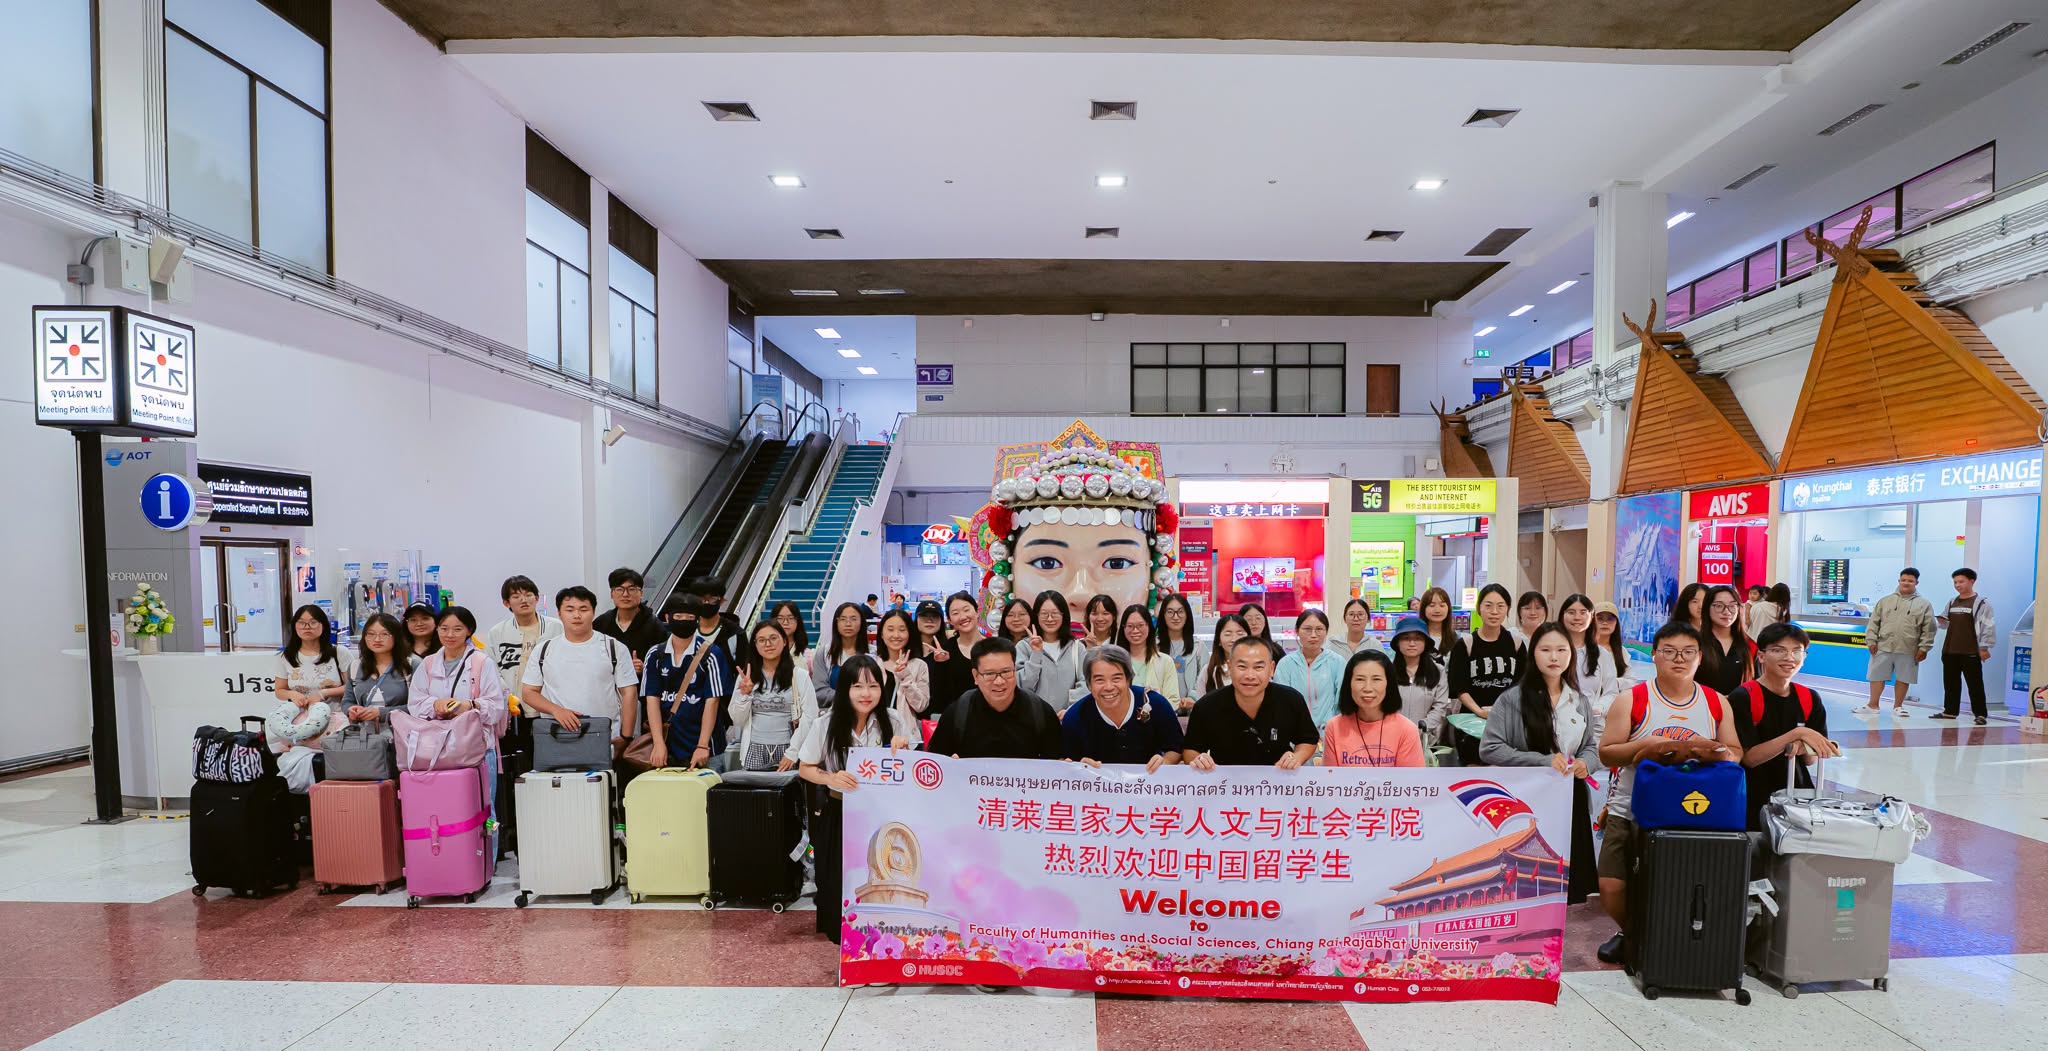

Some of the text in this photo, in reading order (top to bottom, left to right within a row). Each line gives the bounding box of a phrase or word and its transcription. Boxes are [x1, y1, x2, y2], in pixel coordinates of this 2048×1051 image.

[50, 386, 102, 403] จุดนัดพบ
[141, 393, 185, 410] จุดนัดพบ
[39, 405, 68, 415] Meeting
[70, 405, 89, 413] Point
[132, 408, 158, 421] Meeting
[158, 413, 175, 423] Point
[126, 451, 152, 460] AOT
[1812, 480, 1853, 495] Krungthai
[1866, 473, 1926, 497] 泰京银行
[1940, 458, 2041, 487] EXCHANGE
[1440, 484, 1467, 492] TOURIST
[1468, 484, 1481, 492] SIM
[1362, 493, 1382, 509] 5G
[1435, 493, 1468, 501] INTERNET
[212, 502, 239, 513] ooperated
[239, 503, 258, 515] Security
[259, 504, 275, 515] Center
[1208, 503, 1300, 517] 这里卖上网卡
[1708, 492, 1749, 517] AVIS
[927, 528, 950, 540] DQ
[1704, 562, 1729, 575] 100
[107, 572, 168, 581] NFORMATION
[969, 774, 1439, 801] คณะมนุษยศาสตร์และสังคมศาสตร์ มหาวิทยาลัยราชภัฏเชียงราย
[977, 797, 1422, 839] 清莱皇家大学人文与社会学院
[1044, 842, 1352, 881] 热烈欢迎中国留学生
[1827, 876, 1867, 888] hippo
[1119, 888, 1281, 920] Welcome
[1189, 919, 1209, 932] to
[969, 924, 1017, 941] Faculty
[1022, 927, 1036, 939] of
[1040, 927, 1116, 941] Humanities
[1120, 933, 1145, 943] and
[1151, 934, 1192, 946] Social
[1197, 936, 1260, 950] Sciences,
[1265, 938, 1314, 952] Chiang
[1318, 937, 1339, 948] Rai
[1343, 936, 1406, 950] Rajabhat
[1411, 938, 1479, 953] University
